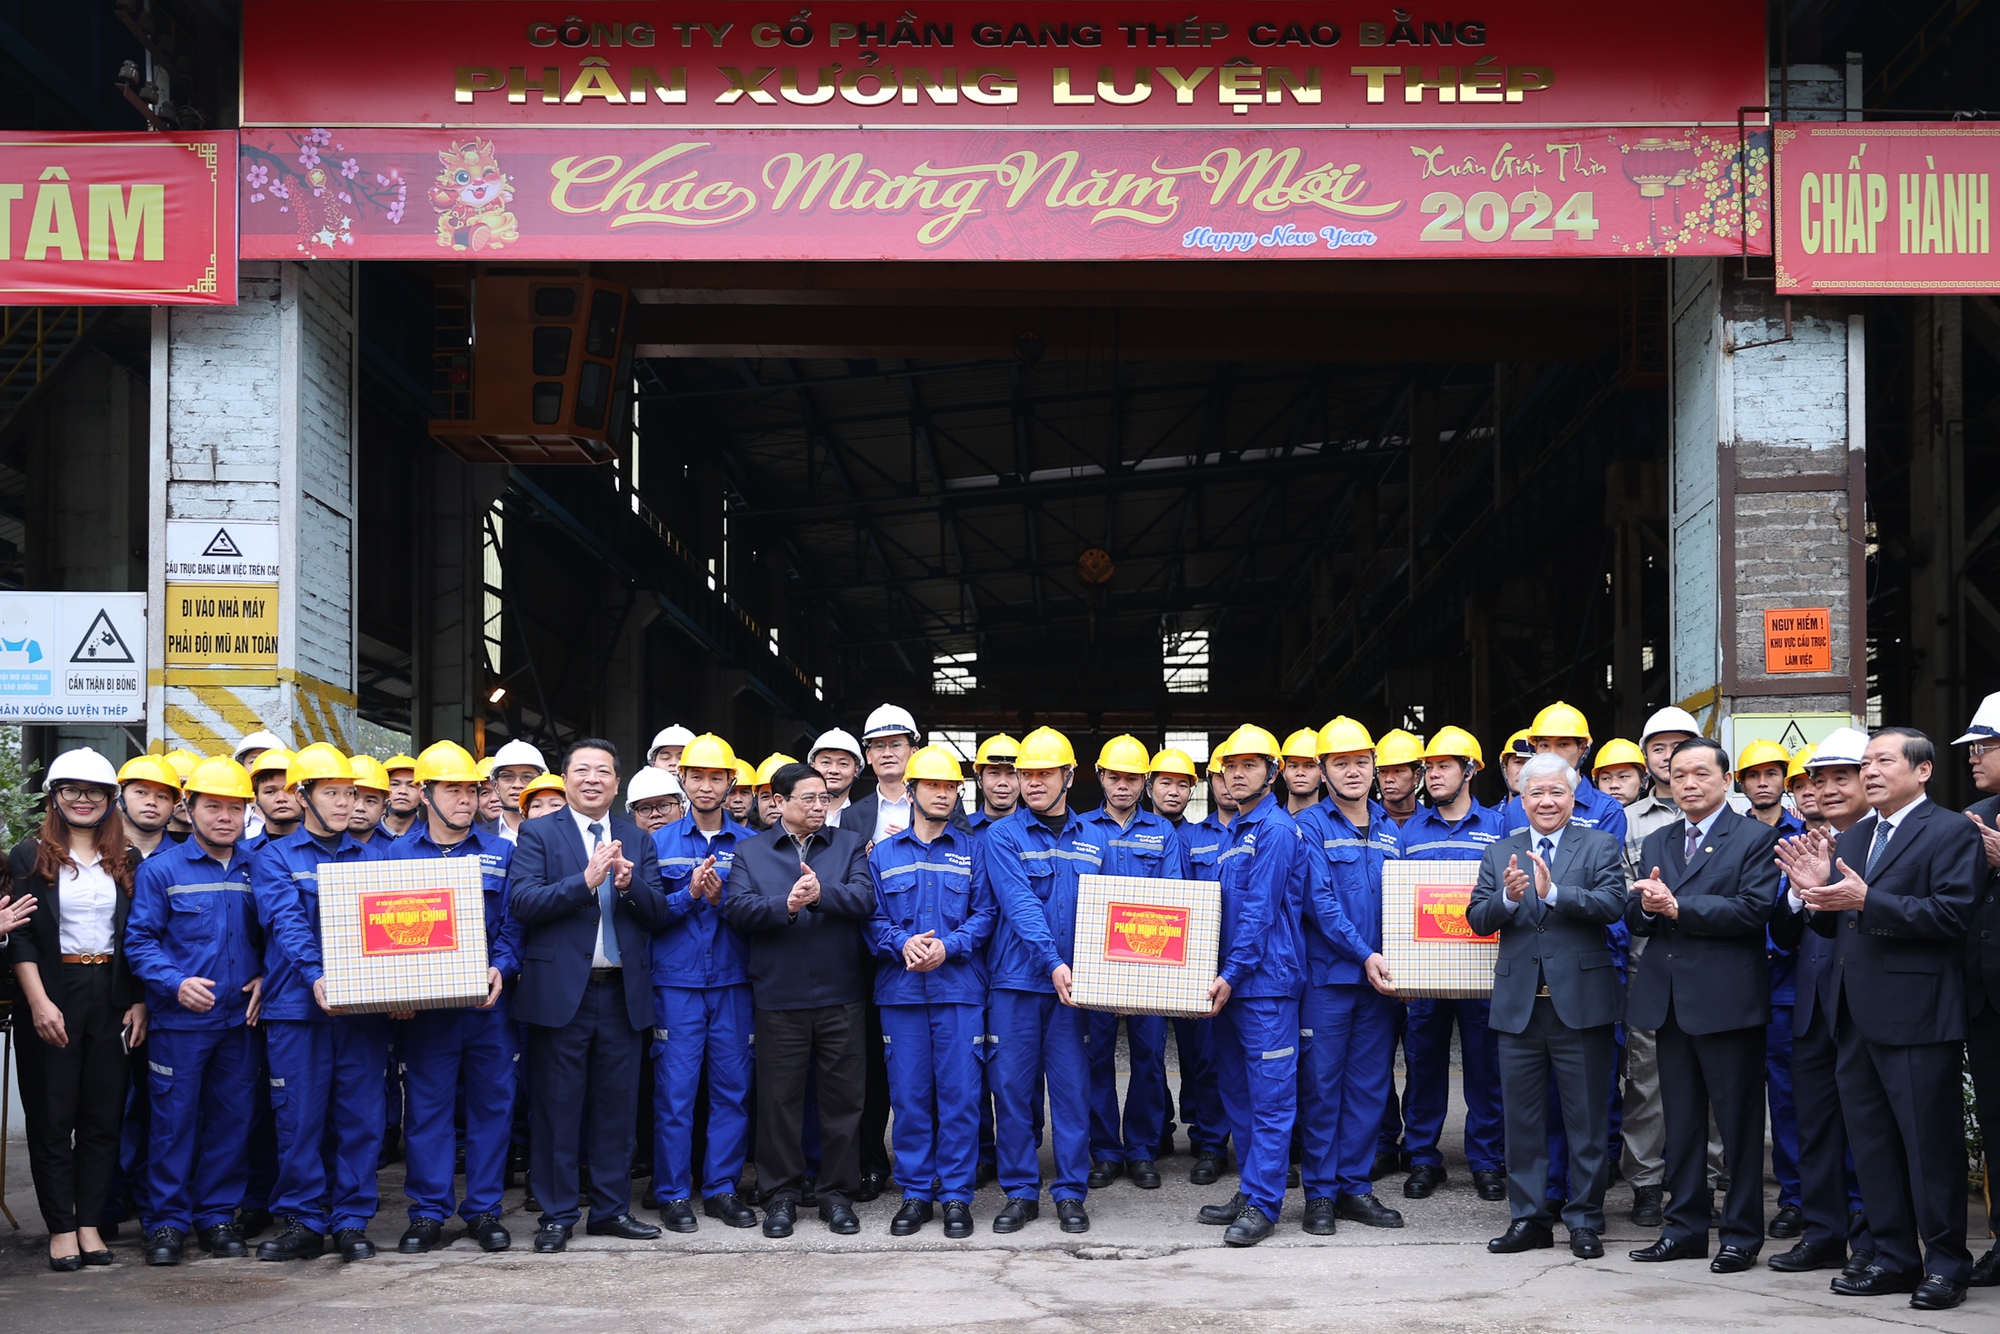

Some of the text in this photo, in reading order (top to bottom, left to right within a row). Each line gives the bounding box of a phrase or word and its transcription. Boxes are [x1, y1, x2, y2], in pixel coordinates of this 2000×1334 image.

[527, 8, 1486, 48] CÔNG TY CỔ PHẦN GANG THÉP CAO BẰNG
[454, 51, 1556, 114] PHÂN XƯỞNG LUYỆN THÉP
[1410, 142, 1607, 197] Xuân Giáp Thìn
[551, 142, 1401, 244] Chúc Mừng Năm Mới
[1800, 143, 1990, 255] CHẤP HÀNH
[1420, 191, 1600, 242] 2024
[1184, 223, 1377, 251] Happy New Year
[180, 563, 196, 577] TRỤC
[198, 563, 215, 574] ĐANG
[217, 562, 231, 575] LÀM
[233, 562, 247, 578] VIỆC
[249, 563, 266, 576] TRÊN
[182, 596, 266, 618] ĐI VÀO NHÀ MÁY
[1772, 618, 1794, 631] NGUY
[1796, 613, 1818, 630] HIỂM
[168, 629, 278, 656] PHẢI ĐỘI MŨ AN TOÀN
[1770, 637, 1783, 648] KHU
[1811, 637, 1827, 649] TRỤC
[1785, 653, 1813, 667] LÀM VIỆC
[86, 676, 104, 693] THẬN
[107, 678, 115, 693] BỊ
[67, 703, 99, 717] LUYỆN
[102, 703, 128, 715] THÉP
[397, 911, 420, 924] MINH
[421, 907, 448, 922] CHÍNH
[1137, 924, 1158, 936] MINH
[1158, 924, 1182, 938] CHÍNH
